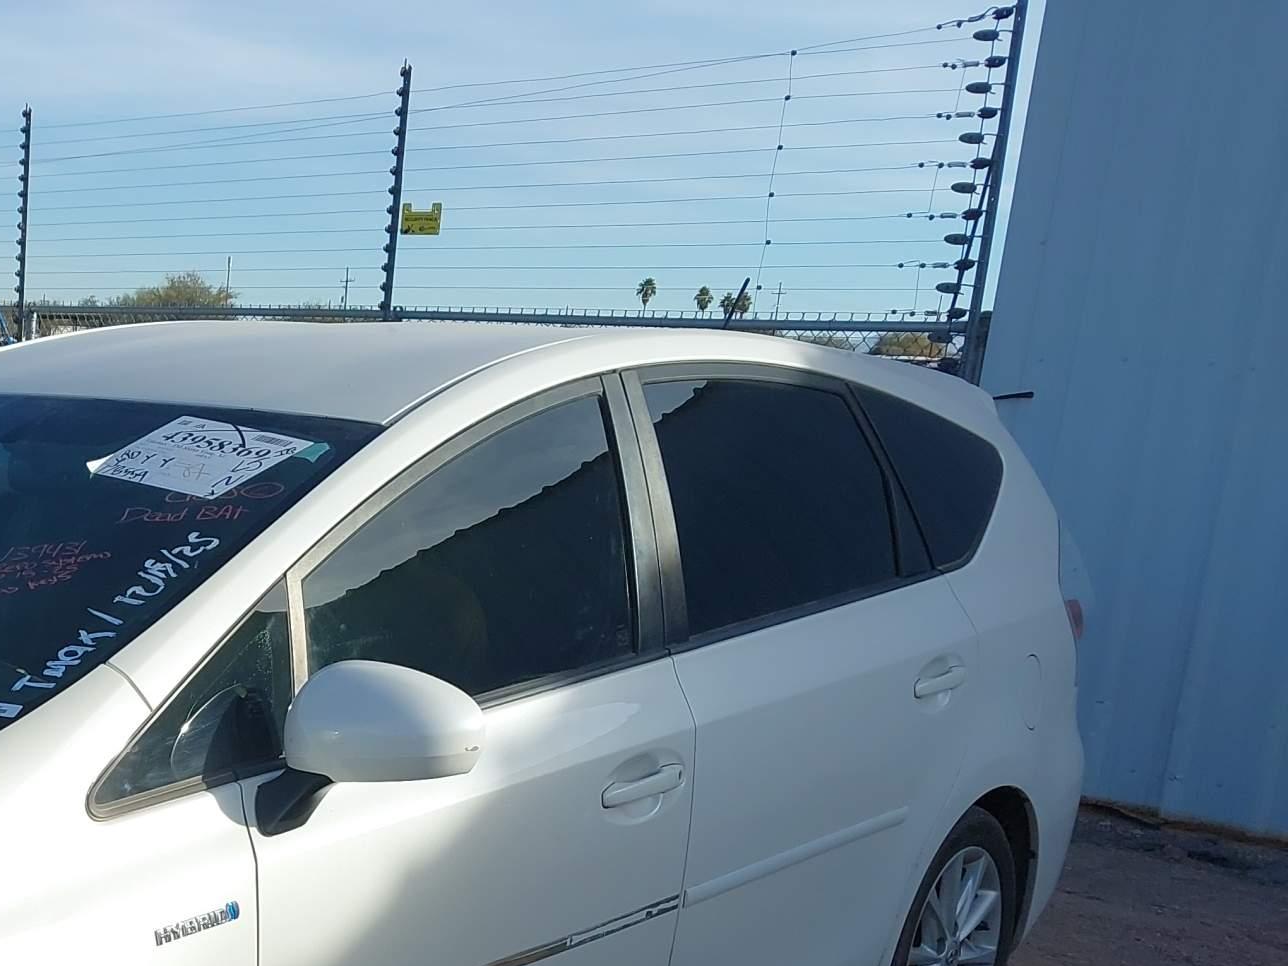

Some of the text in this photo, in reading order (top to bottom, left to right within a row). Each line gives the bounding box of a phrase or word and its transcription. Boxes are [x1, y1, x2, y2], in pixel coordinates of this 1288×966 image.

[162, 431, 271, 460] 43958369
[115, 507, 189, 524] Dead
[154, 907, 229, 946] HYBRID
